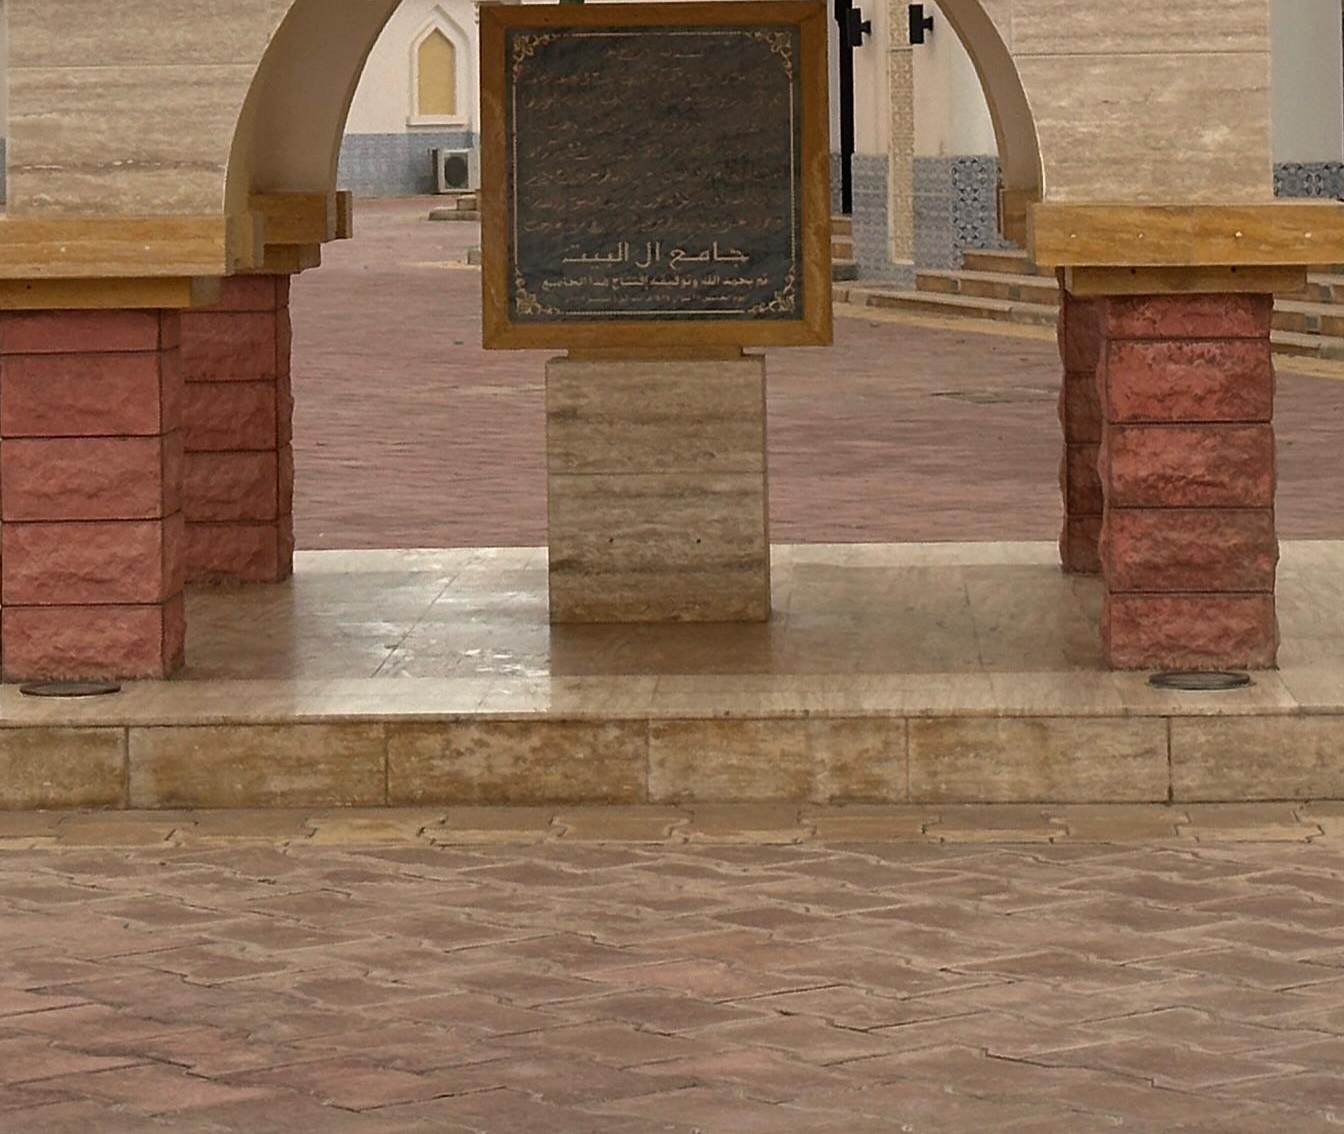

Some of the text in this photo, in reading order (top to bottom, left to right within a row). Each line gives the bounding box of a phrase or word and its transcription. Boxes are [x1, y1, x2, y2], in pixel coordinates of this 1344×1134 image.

[561, 241, 630, 269] البيت
[669, 241, 750, 270] جامع
[701, 274, 721, 287] الله
[722, 275, 754, 288] بحمد
